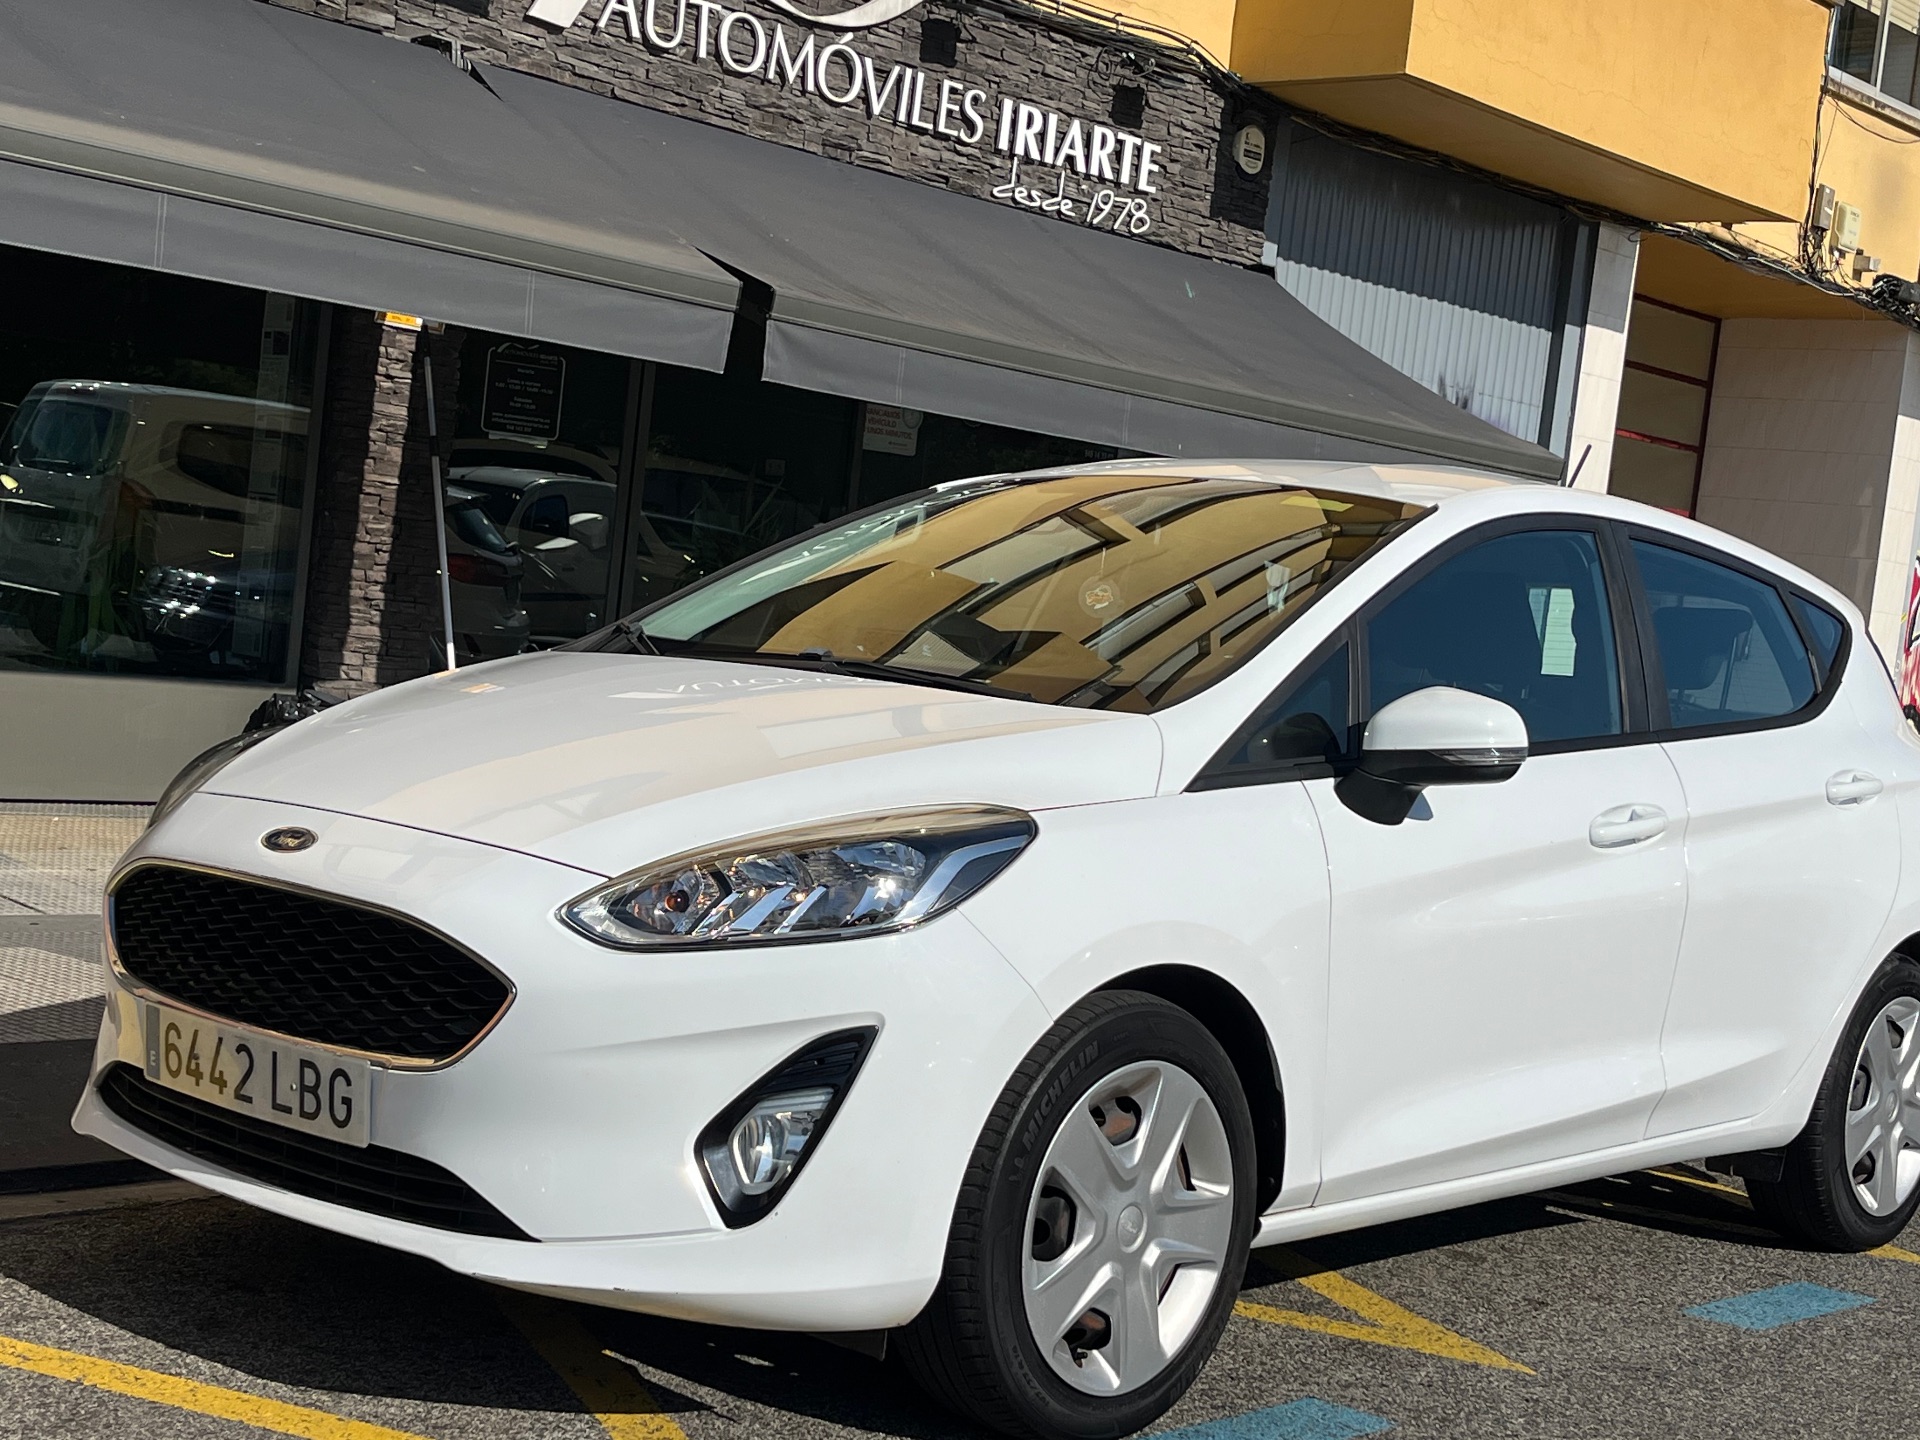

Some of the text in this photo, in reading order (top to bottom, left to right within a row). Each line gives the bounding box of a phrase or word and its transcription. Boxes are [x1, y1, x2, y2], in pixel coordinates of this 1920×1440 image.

[598, 0, 1162, 193] AUTOMÓVILES IRIARTE
[993, 157, 1150, 233] desde 1978
[149, 1050, 157, 1067] E
[164, 1021, 353, 1129] 6442 LBG
[1022, 1040, 1100, 1152] MICHELIN
